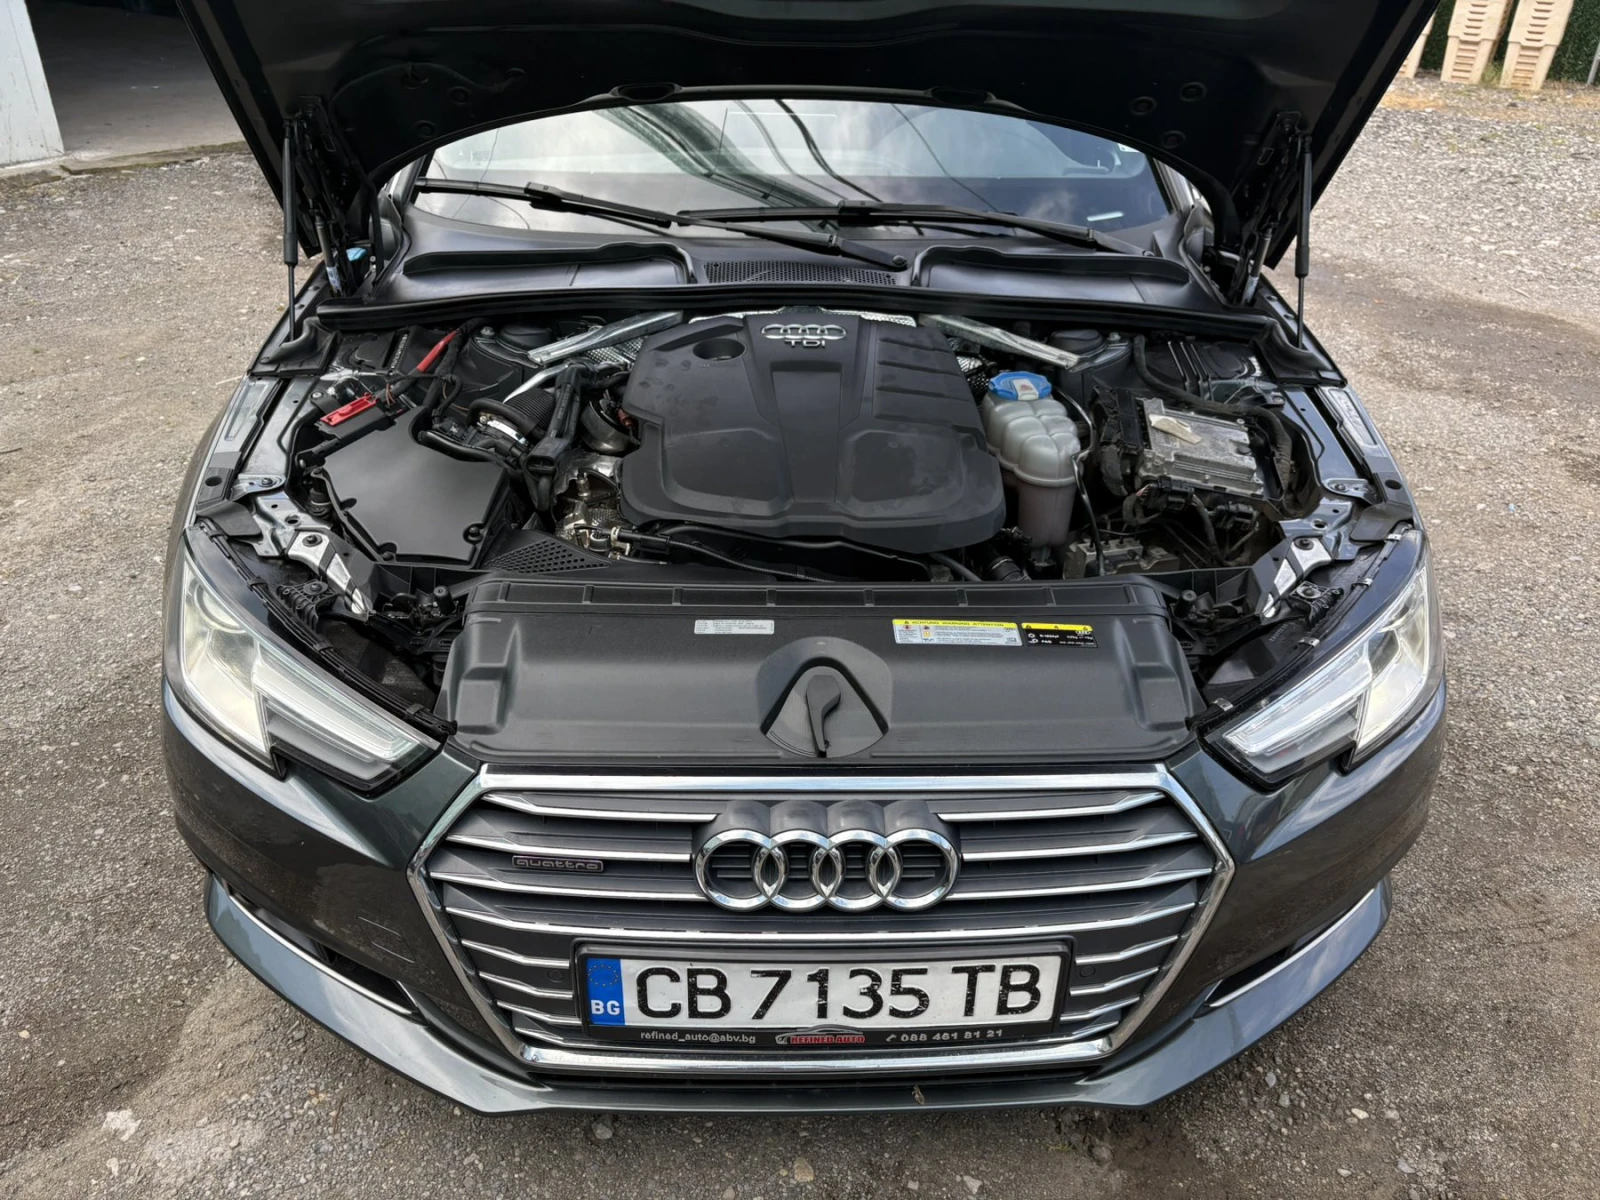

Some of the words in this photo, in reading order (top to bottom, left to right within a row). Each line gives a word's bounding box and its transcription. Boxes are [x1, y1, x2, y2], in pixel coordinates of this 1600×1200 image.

[784, 339, 826, 348] TDI
[516, 859, 599, 870] quattro
[635, 967, 732, 1019] CB
[750, 967, 930, 1019] 7135
[951, 964, 1041, 1017] TB
[591, 1000, 620, 1016] BG
[640, 1030, 756, 1044] refined_auto@abv.bg
[790, 1035, 834, 1044] REFINED
[835, 1034, 865, 1044] AUTO
[900, 1033, 927, 1042] 088
[932, 1032, 958, 1040] 461
[964, 1031, 980, 1039] 81
[986, 1029, 1003, 1038] 21
